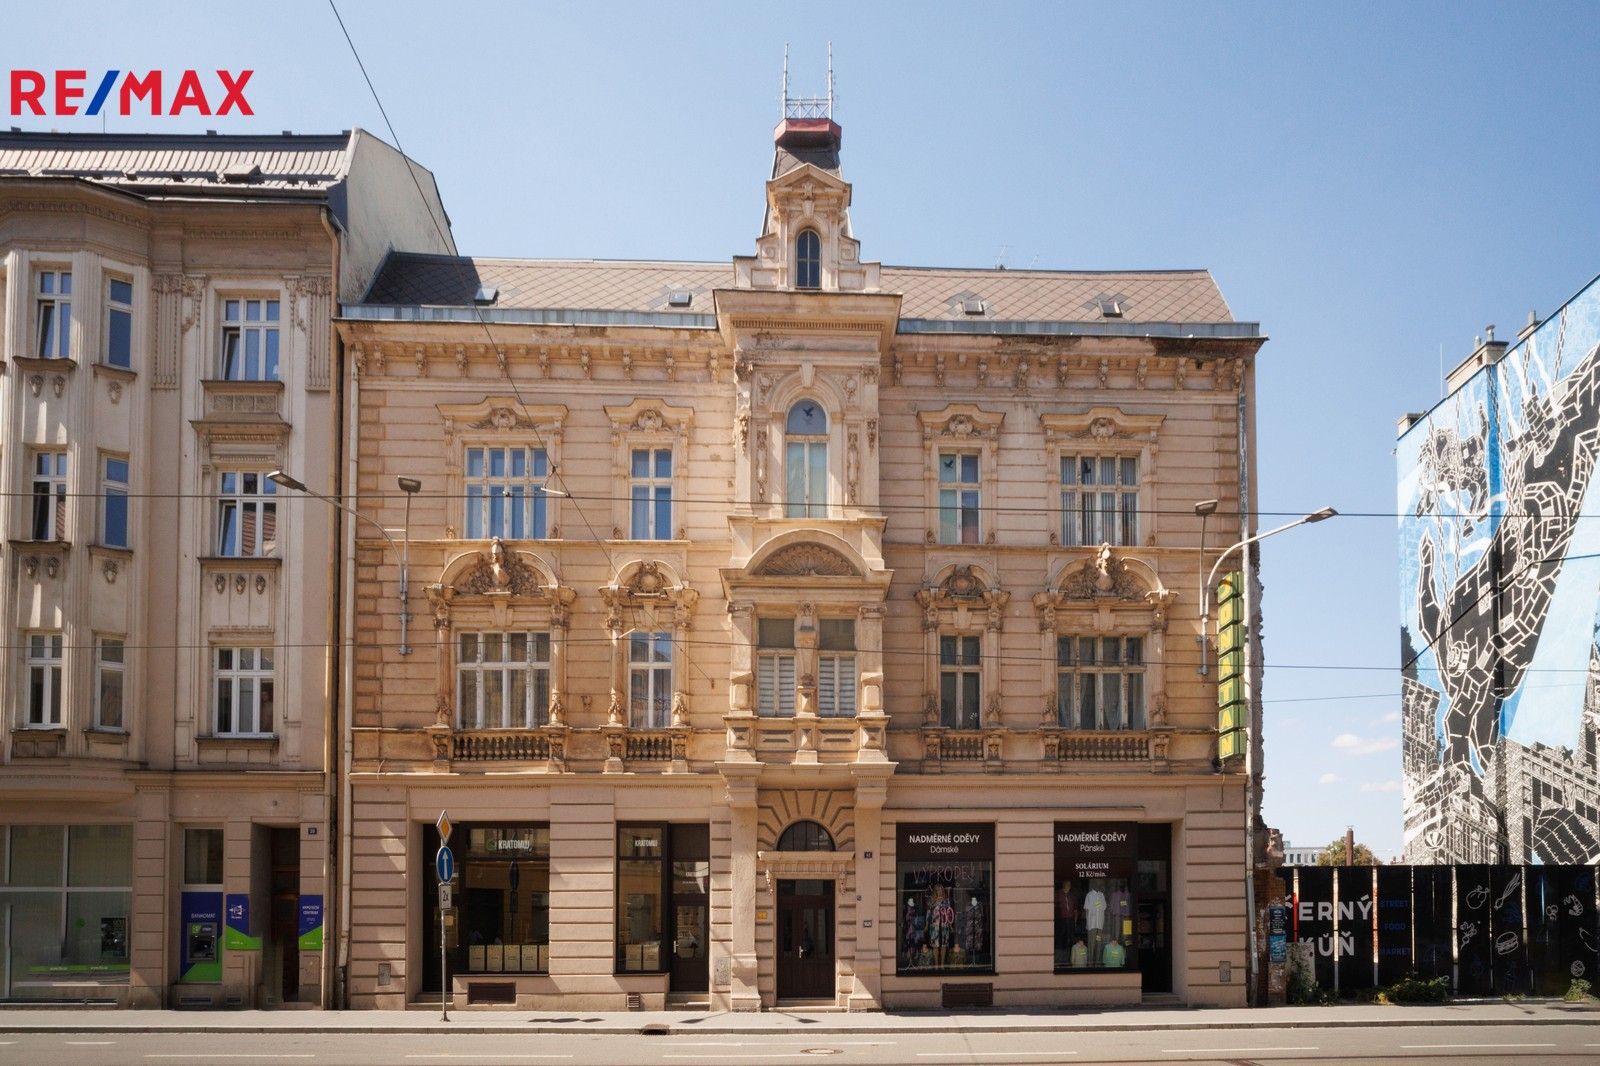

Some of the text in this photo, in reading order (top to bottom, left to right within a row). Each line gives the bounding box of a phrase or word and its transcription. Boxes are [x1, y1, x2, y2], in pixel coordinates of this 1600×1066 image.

[909, 833, 980, 843] NADMĚRNÉ ODĚVY
[1057, 832, 1127, 842] NADMĚRNÉ ODĚVY
[930, 845, 959, 854] Dámské
[1079, 844, 1105, 852] Pánské
[1075, 862, 1109, 870] SOLÁRIUM
[1285, 894, 1373, 921] ERNÝ
